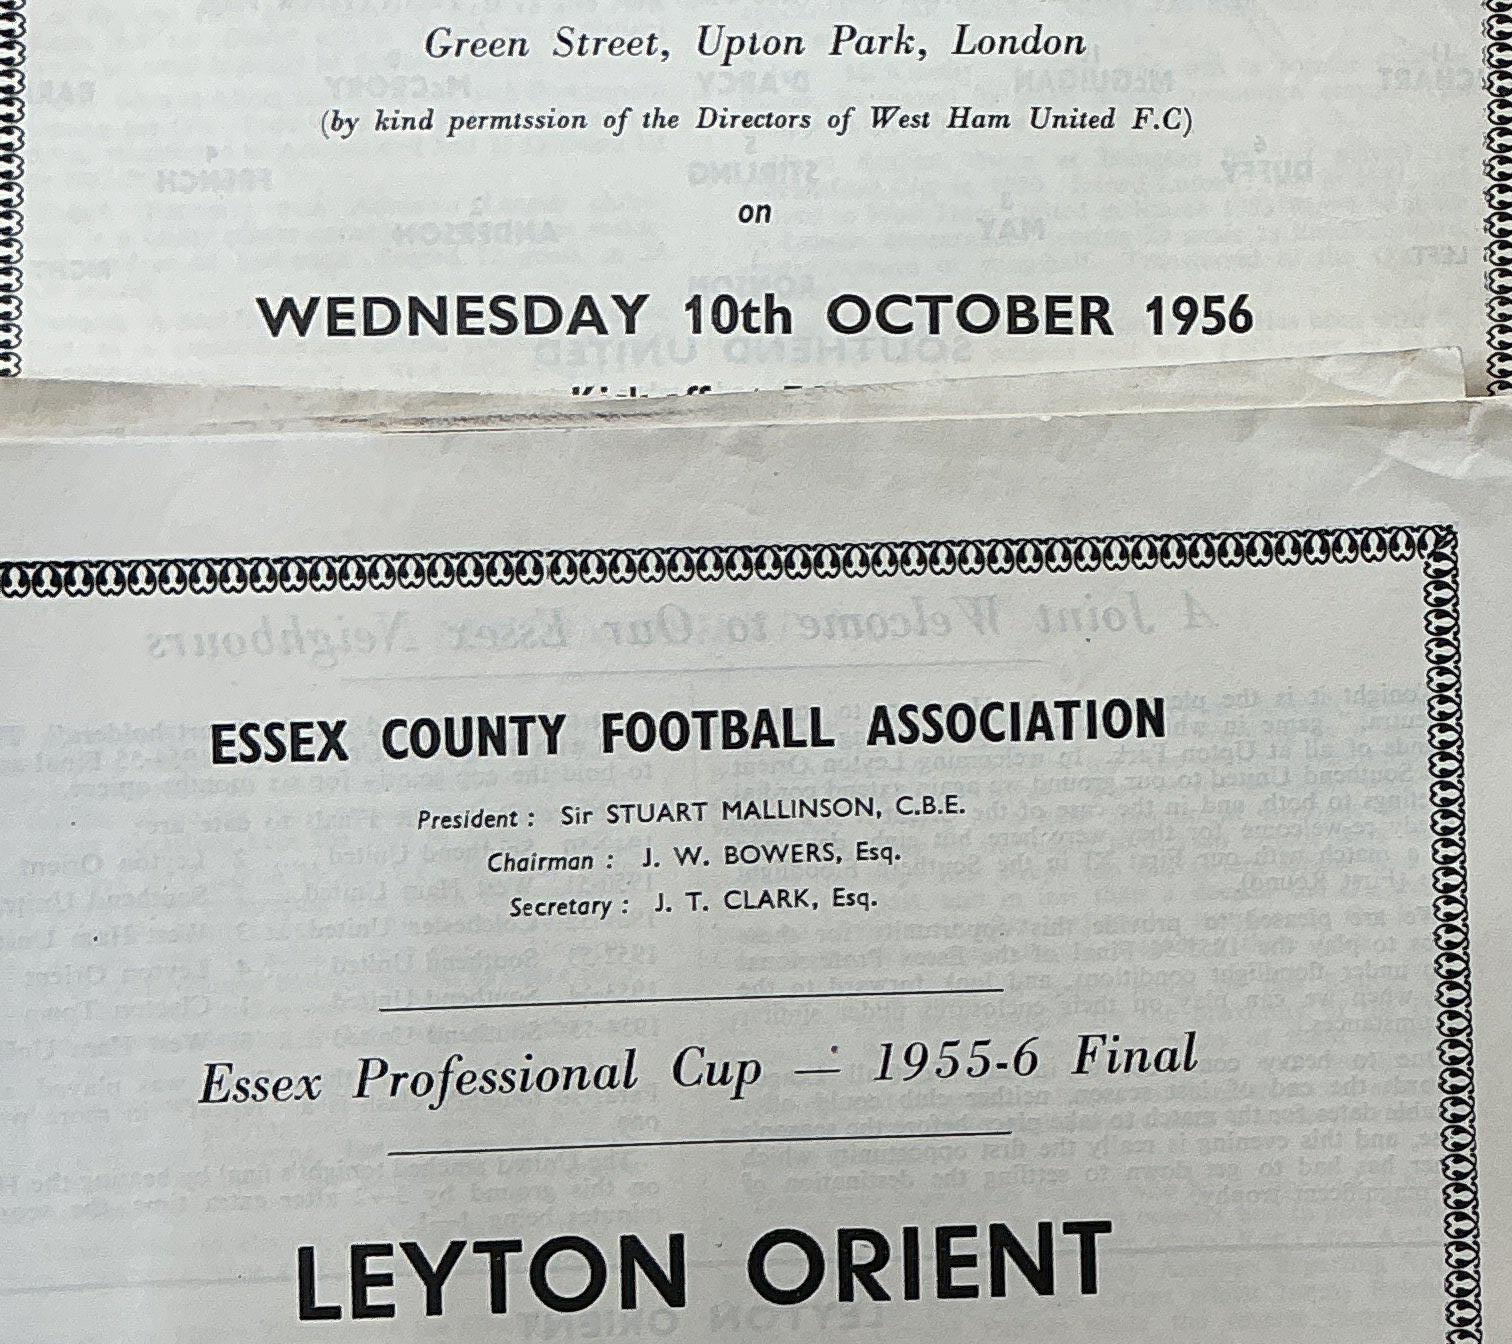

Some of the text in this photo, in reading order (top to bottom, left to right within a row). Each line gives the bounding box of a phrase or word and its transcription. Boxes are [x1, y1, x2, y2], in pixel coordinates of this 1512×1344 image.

[425, 26, 530, 59] Green
[552, 25, 670, 63] Street,
[828, 23, 928, 62] Park,
[950, 23, 1087, 56] London
[737, 203, 772, 224] on
[255, 292, 1254, 338] WEDNESDAY 10th OCTOBER 1956
[209, 697, 1166, 765] ESSEX COUNTY FOOTBALL ASSOCIATION
[197, 1030, 1199, 1111] Essex Professional Cup 1955-6 Final
[297, 1220, 1113, 1322] LEYTON ORIENT
